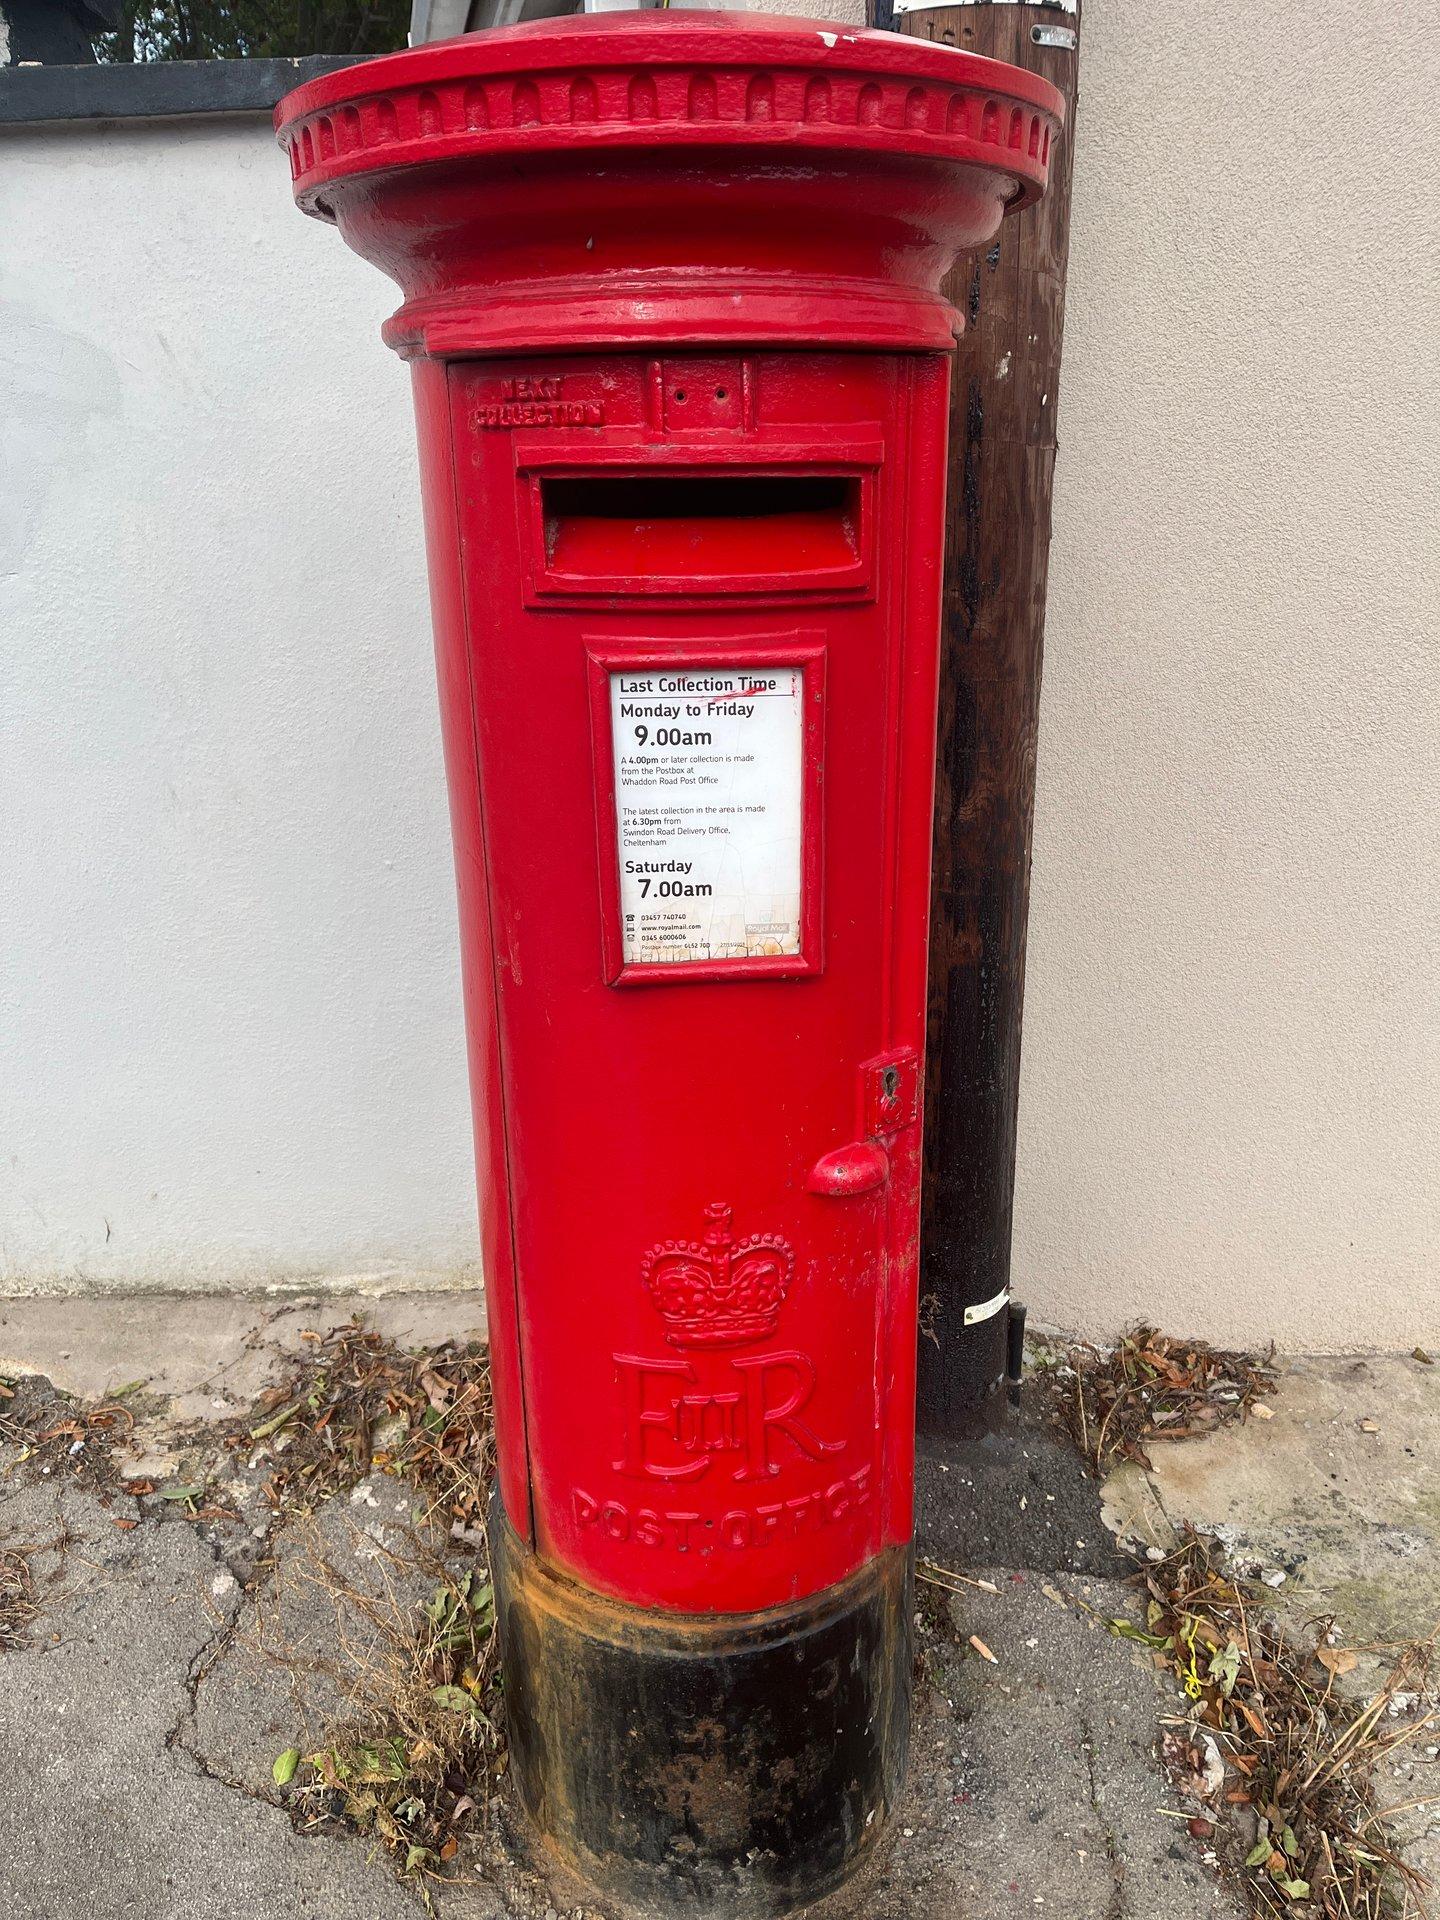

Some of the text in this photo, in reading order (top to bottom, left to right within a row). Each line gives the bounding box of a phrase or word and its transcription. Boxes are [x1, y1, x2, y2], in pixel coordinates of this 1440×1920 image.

[502, 376, 562, 402] NEXT
[476, 400, 605, 428] COLLECTION
[620, 677, 776, 692] Last Collection Time
[621, 703, 754, 719] Monday to Friday
[635, 725, 712, 746] 9.00am
[629, 756, 658, 765] 4.00pm
[690, 755, 723, 763] collection
[622, 767, 639, 775] from
[656, 766, 684, 774] Postbox
[633, 818, 662, 826] 6.30pm
[664, 817, 681, 825] from
[678, 827, 706, 836] Delivery
[626, 860, 692, 874] Saturday
[638, 879, 712, 898] 7.00am
[571, 1486, 700, 1553] POST
